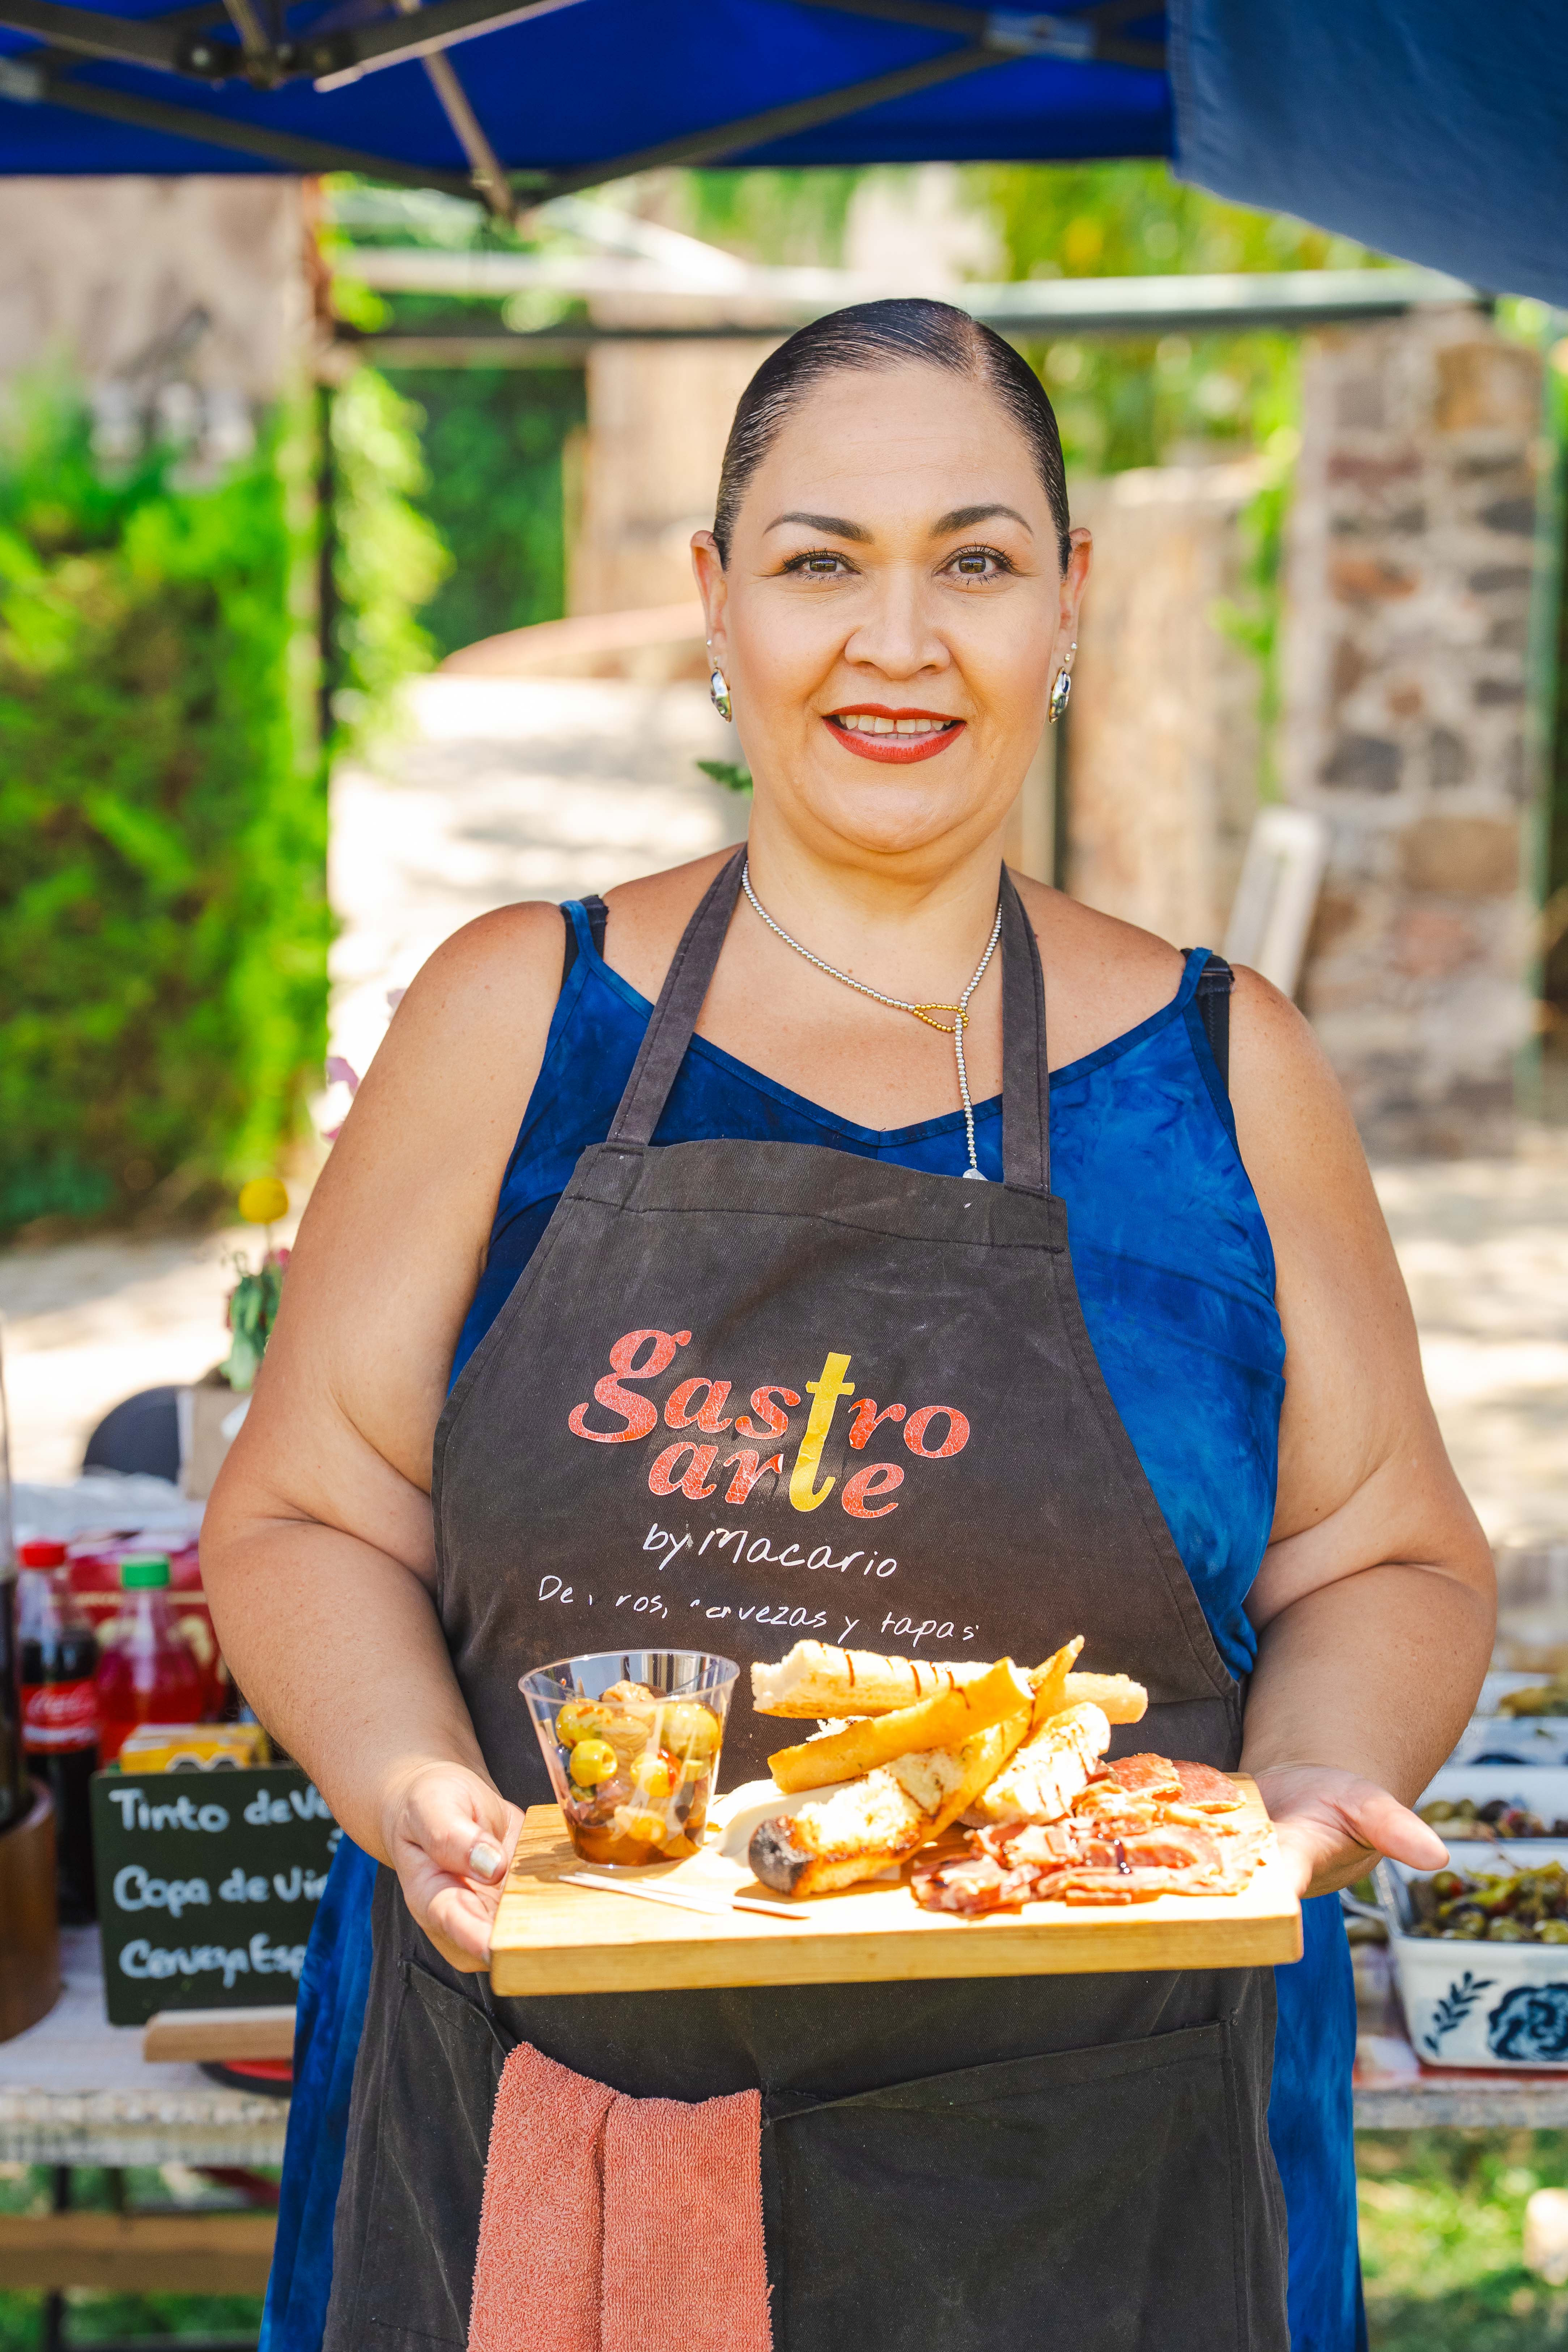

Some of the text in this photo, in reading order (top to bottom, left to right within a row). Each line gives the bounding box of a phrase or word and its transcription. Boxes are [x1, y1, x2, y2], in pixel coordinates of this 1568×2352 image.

[568, 1329, 970, 1512] gastro
[643, 1523, 897, 1577] by Macario
[539, 1575, 573, 1603] De
[837, 1616, 860, 1645] y
[881, 1612, 979, 1648] tapas
[109, 1787, 230, 1833] Tinto
[244, 1789, 293, 1826] de
[112, 1864, 212, 1918] Copa
[218, 1867, 271, 1904] de
[249, 1932, 307, 1980] Esp
